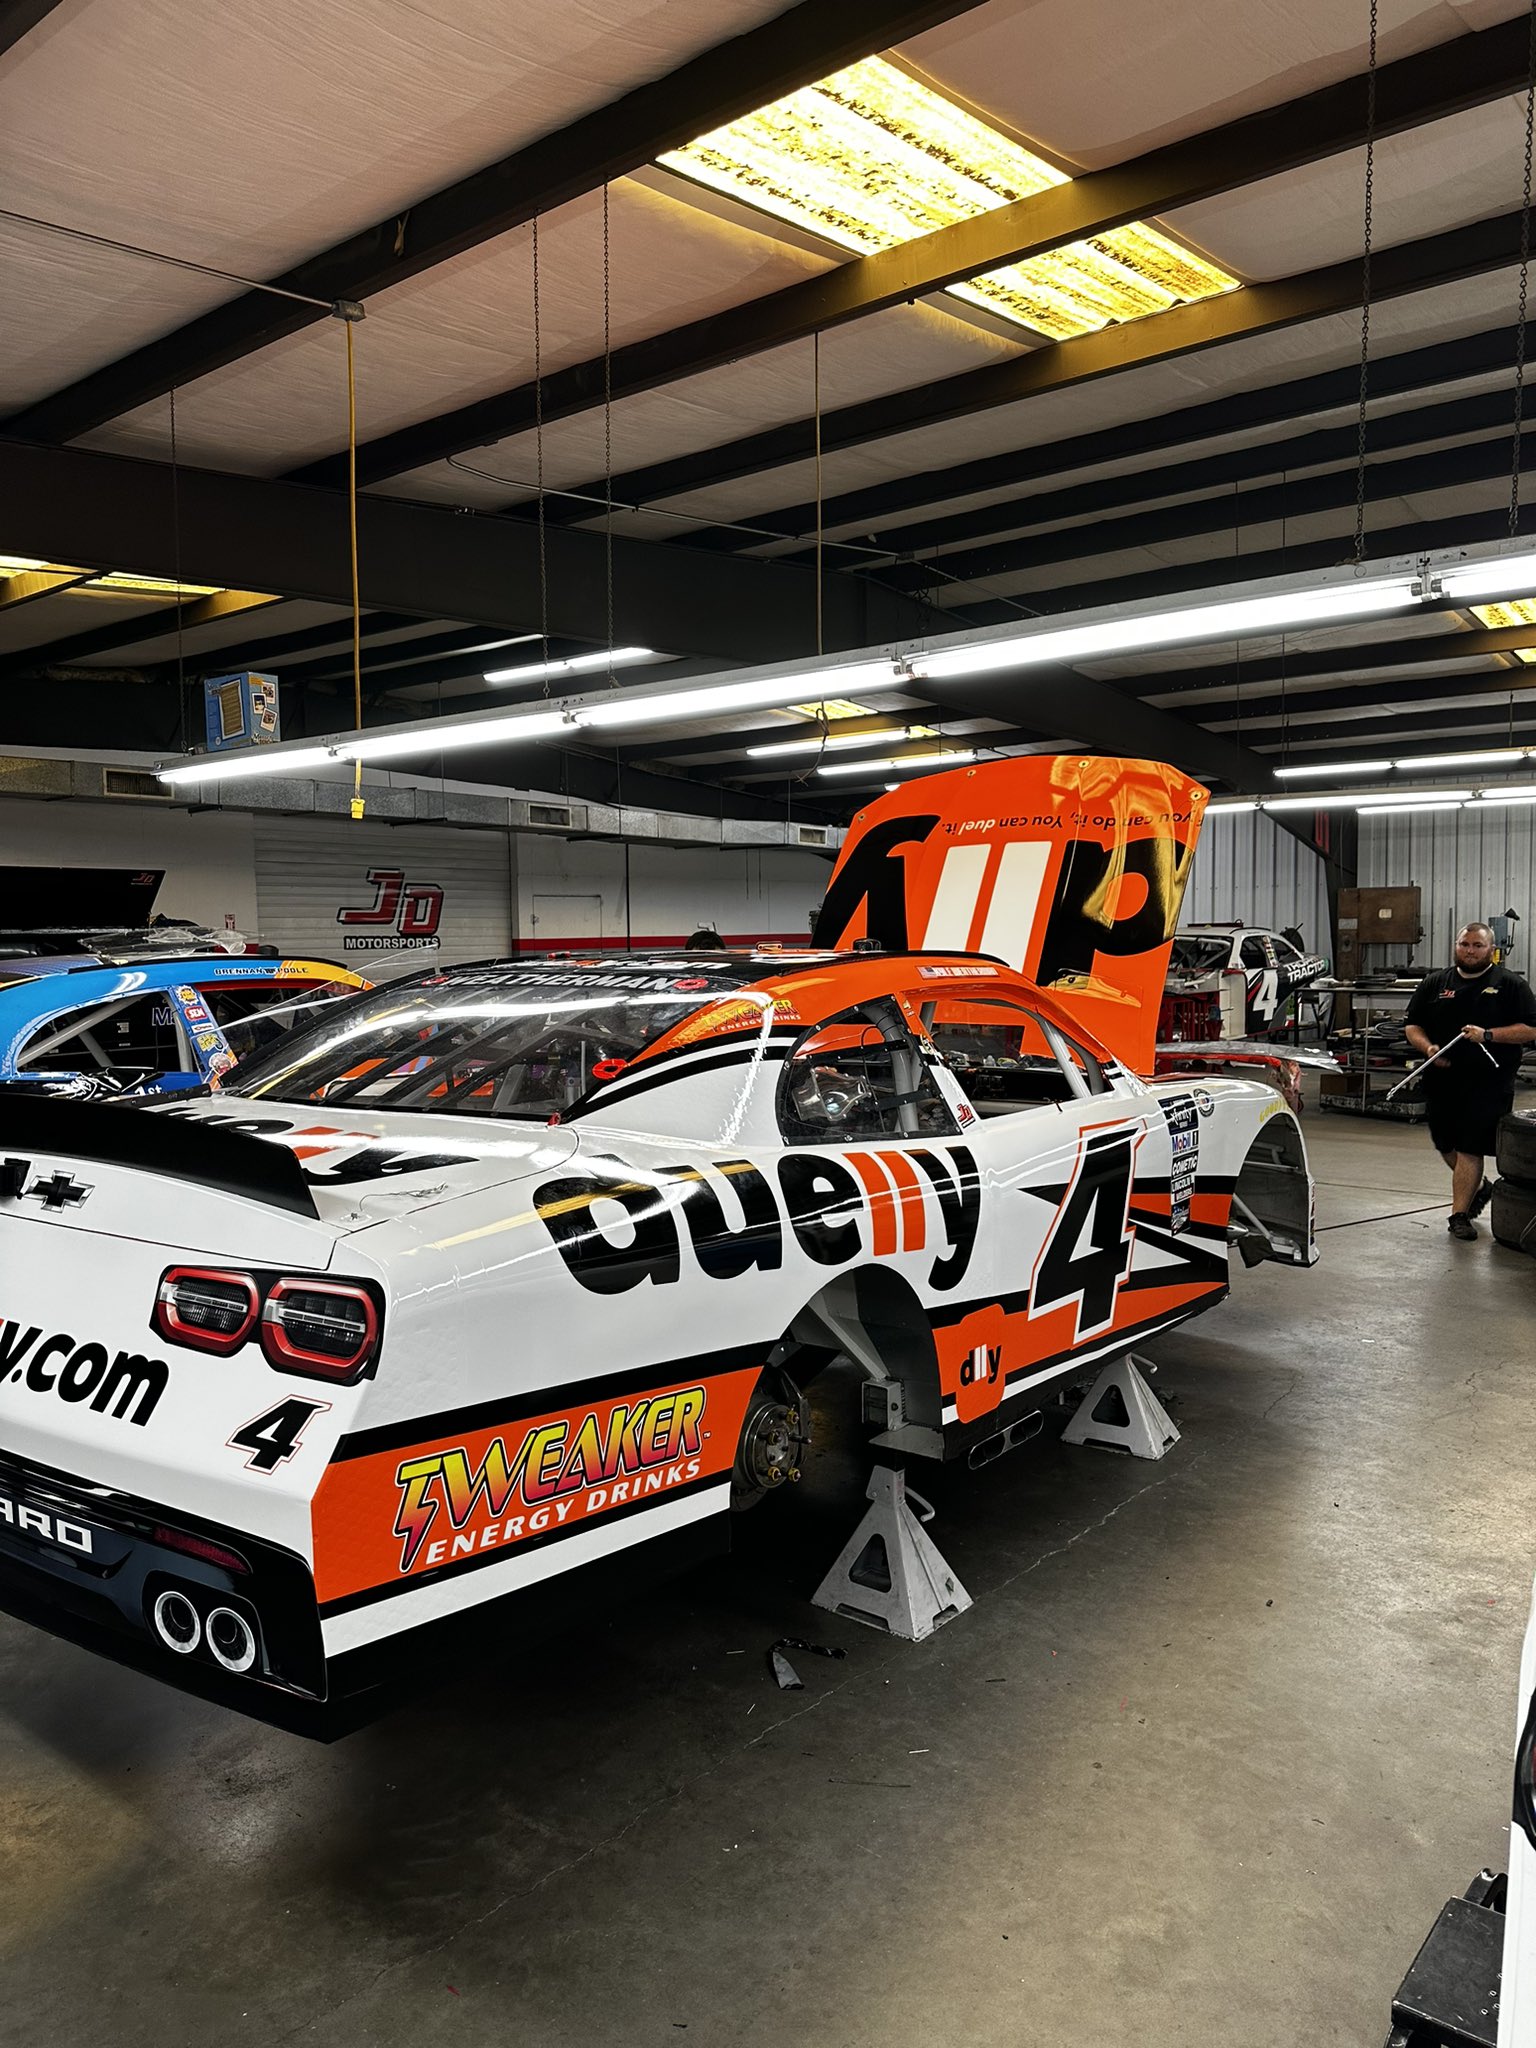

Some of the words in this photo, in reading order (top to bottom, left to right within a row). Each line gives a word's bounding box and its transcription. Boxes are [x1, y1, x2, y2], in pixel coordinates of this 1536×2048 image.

[942, 822, 957, 833] it.
[959, 818, 996, 835] duel
[1000, 816, 1028, 828] can
[1032, 815, 1063, 829] You
[1070, 812, 1089, 829] it,
[1092, 815, 1116, 830] do
[1122, 815, 1153, 827] can
[337, 867, 444, 936] JD
[345, 937, 439, 949] MOTORSPORTS
[214, 967, 262, 975] BRENNAN
[1287, 959, 1324, 982] TRACTOR
[447, 973, 673, 991] WEATHERMAN
[1252, 968, 1279, 1021] 4
[720, 1018, 762, 1032] ENERGY
[1172, 1132, 1191, 1153] Mobil
[1173, 1155, 1198, 1176] COMETIC
[1030, 1120, 1146, 1347] 4
[0, 1319, 169, 1427] y.com
[227, 1395, 331, 1474] 4
[394, 1386, 705, 1572] TWEAKER
[424, 1499, 574, 1566] ENERGY
[586, 1457, 701, 1513] DRINKS
